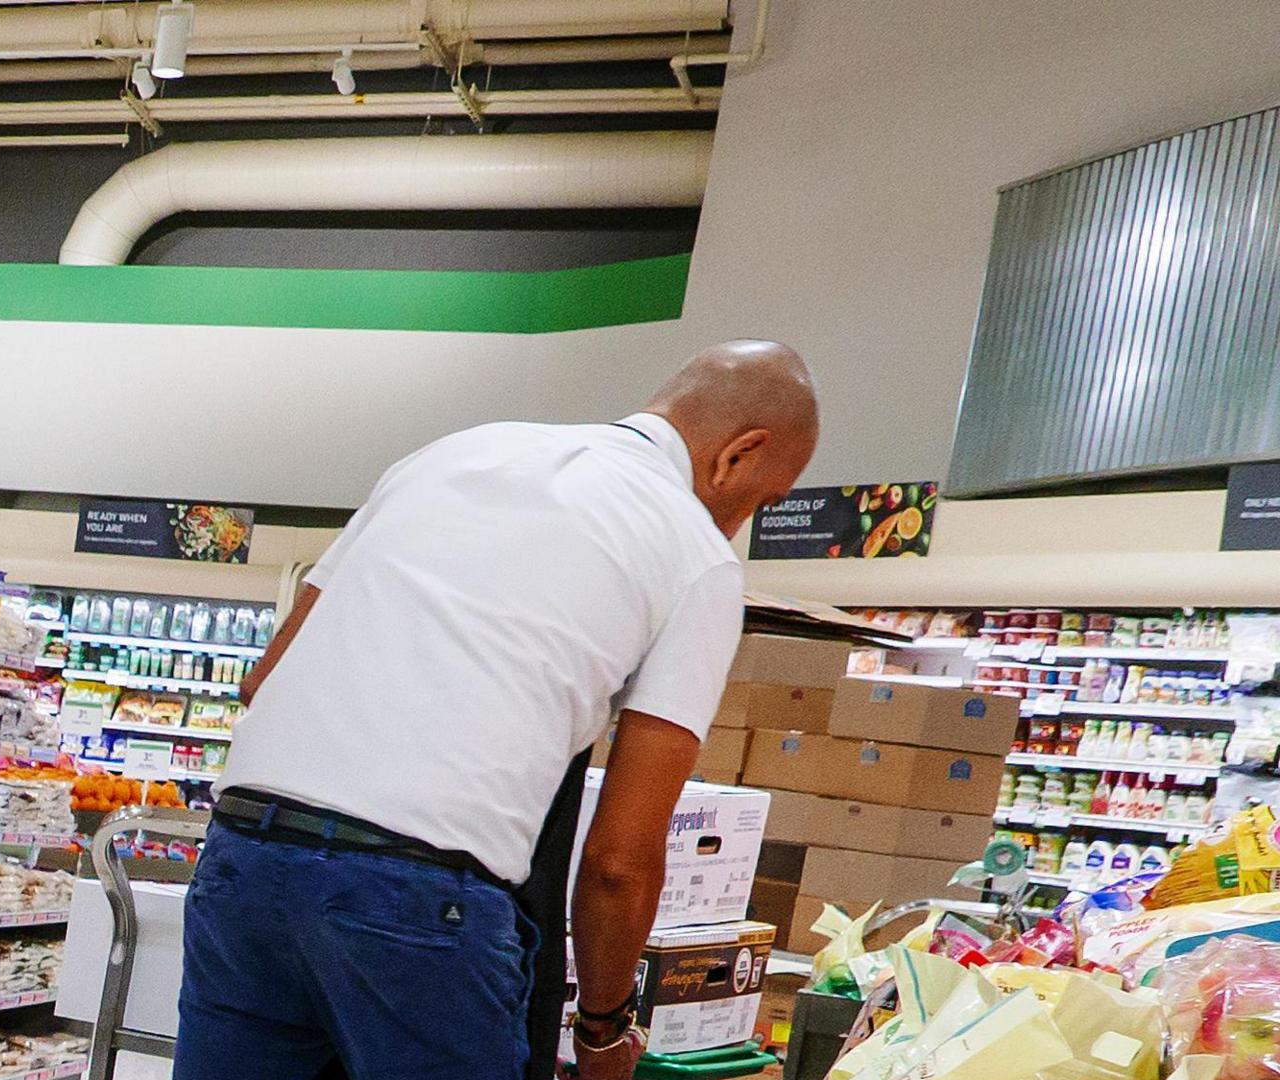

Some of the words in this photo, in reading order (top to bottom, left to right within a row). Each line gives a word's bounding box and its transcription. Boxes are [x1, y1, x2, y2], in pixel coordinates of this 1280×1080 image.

[812, 499, 826, 510] OF
[87, 511, 117, 522] READY
[119, 512, 147, 523] WHEN
[761, 515, 811, 528] GOODNESS
[86, 523, 104, 532] YOU
